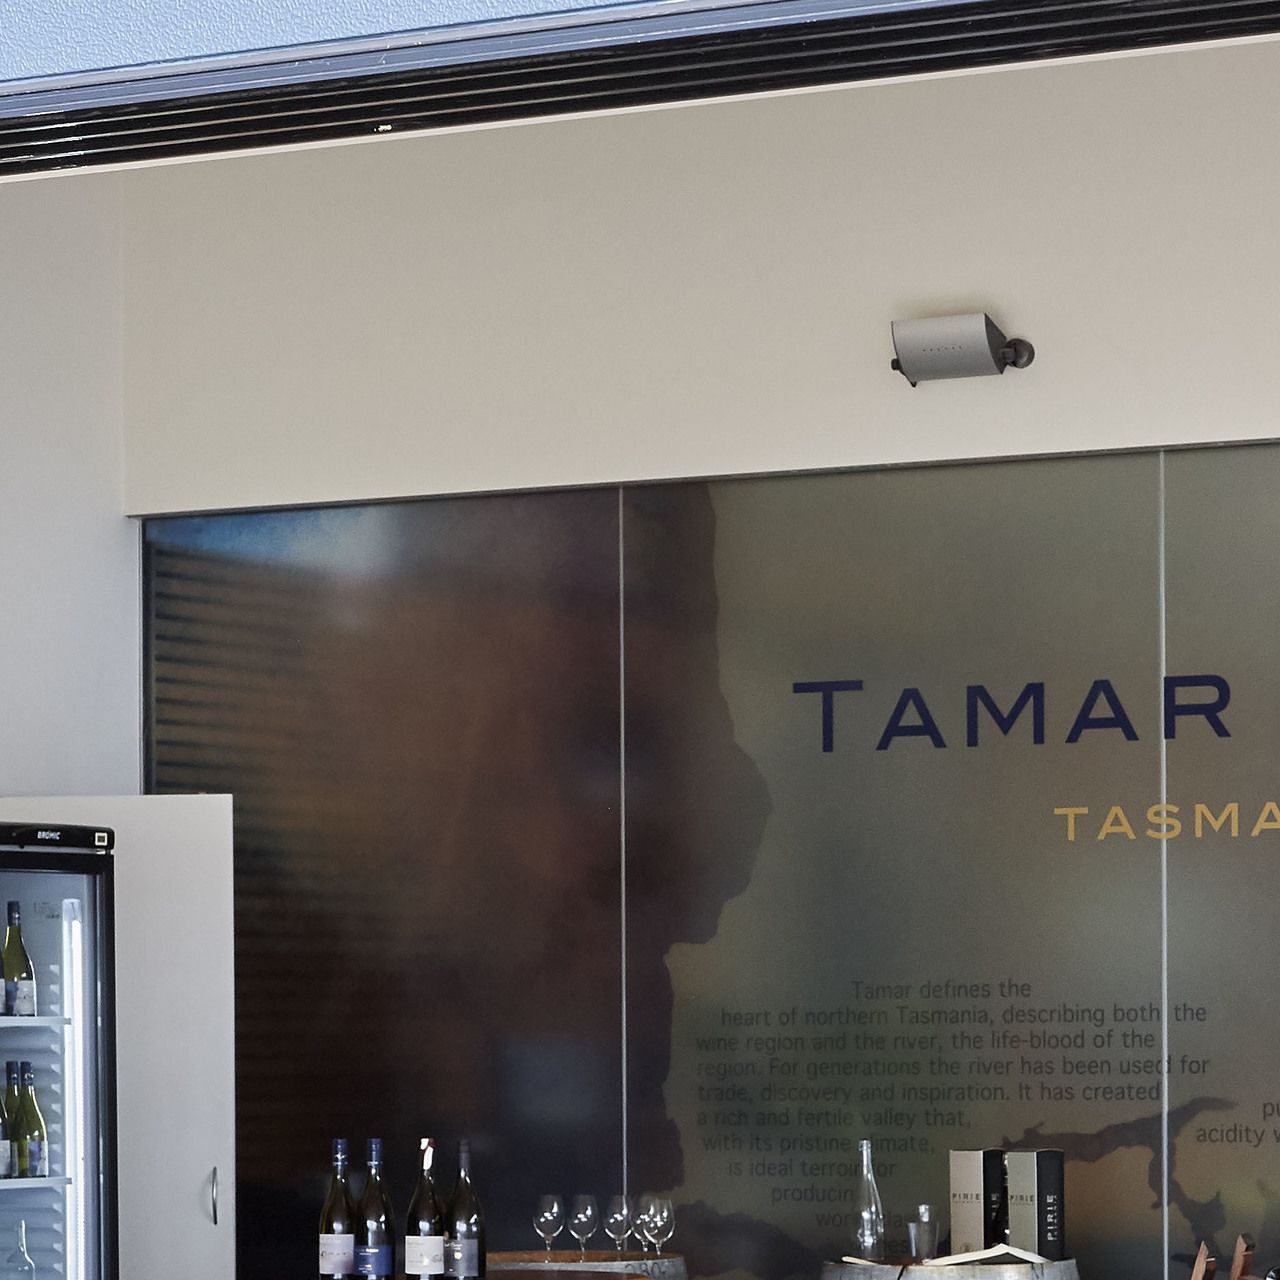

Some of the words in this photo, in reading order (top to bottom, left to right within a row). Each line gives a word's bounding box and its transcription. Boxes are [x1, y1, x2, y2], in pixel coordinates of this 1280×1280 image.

[792, 673, 1233, 754] TAMAR
[851, 980, 912, 1000] Tamar
[919, 979, 990, 998] defines
[999, 978, 1031, 998] the
[721, 1008, 771, 1027] heart
[778, 1007, 798, 1026] of
[804, 1006, 888, 1025] northern
[896, 1006, 994, 1027] Tasmania,
[1002, 1004, 1105, 1027] describing
[1113, 1003, 1160, 1023] both
[1173, 1002, 1207, 1022] the
[695, 1035, 738, 1051] wine
[745, 1033, 805, 1055] region
[812, 1032, 847, 1051] and
[855, 1032, 886, 1051] the
[893, 1032, 943, 1053] river,
[951, 1031, 983, 1050] the
[991, 1029, 1085, 1050] life-blood
[1093, 1029, 1114, 1049] of
[1121, 1028, 1155, 1049] the
[769, 1057, 801, 1077] For
[807, 1058, 921, 1080] generations
[929, 1056, 960, 1076] the
[968, 1056, 1014, 1076] river
[1020, 1055, 1054, 1075] has
[1062, 1055, 1111, 1075] been
[1119, 1054, 1171, 1074] used
[1180, 1054, 1211, 1074] for
[697, 1085, 752, 1104] trade,
[761, 1084, 852, 1105] discovery
[859, 1083, 896, 1103] and
[902, 1083, 1010, 1106] inspiration.
[1018, 1082, 1035, 1101] It
[1040, 1082, 1075, 1101] has
[1082, 1081, 1160, 1101] created
[697, 1114, 707, 1127] a
[714, 1109, 749, 1127] rich
[756, 1108, 791, 1127] and
[797, 1108, 855, 1127] fertile
[861, 1108, 916, 1130] valley
[924, 1108, 971, 1129] that,
[703, 1134, 743, 1153] with
[749, 1134, 772, 1153] its
[780, 1134, 851, 1155] pristine
[870, 1133, 935, 1154] limate,
[1195, 1126, 1265, 1148] acidity
[728, 1161, 743, 1177] is
[749, 1159, 793, 1177] ideal
[800, 1160, 862, 1178] terroir
[771, 1184, 856, 1206] producin
[952, 1192, 981, 1201] PIRIE
